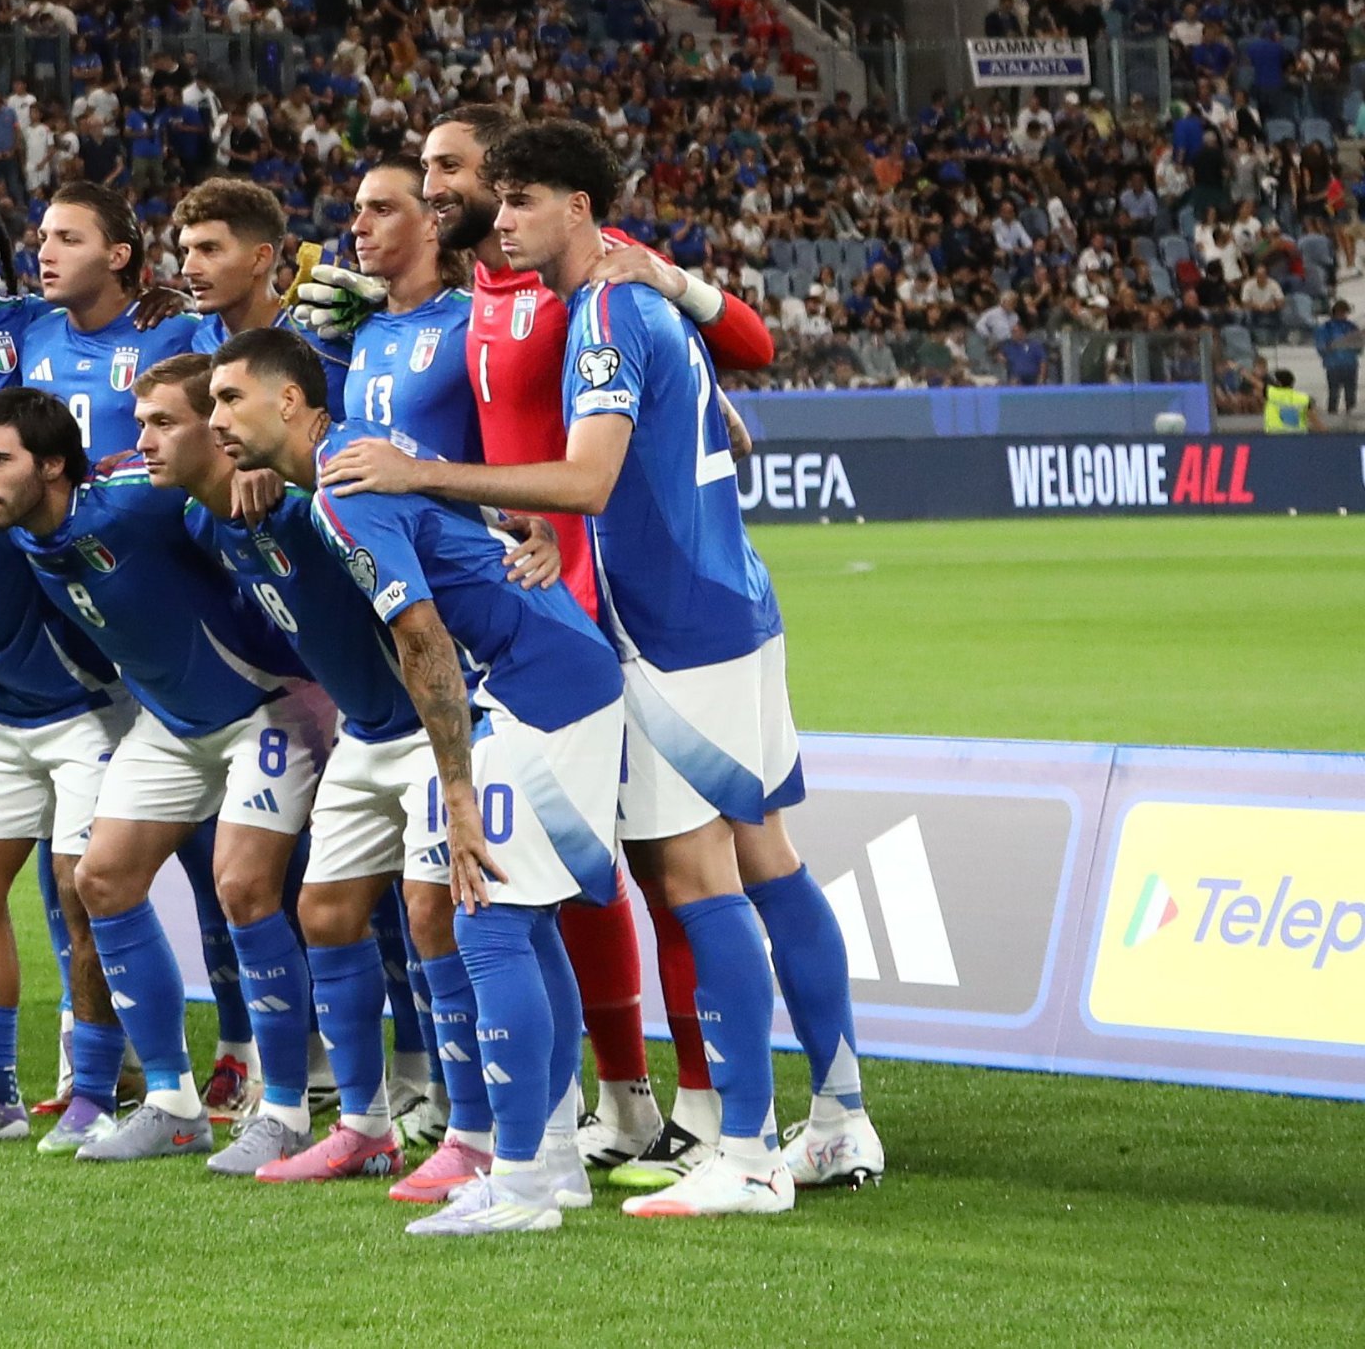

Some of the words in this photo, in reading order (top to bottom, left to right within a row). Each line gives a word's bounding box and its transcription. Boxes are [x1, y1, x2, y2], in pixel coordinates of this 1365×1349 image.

[990, 62, 1070, 75] ATALANTA
[479, 343, 491, 403] 1
[70, 394, 91, 448] 9
[365, 375, 394, 427] 13
[737, 453, 857, 510] UEFA
[1007, 443, 1169, 508] WELCOME
[1172, 443, 1255, 504] ALL
[67, 582, 106, 629] 8
[252, 582, 299, 633] 18
[258, 729, 287, 777] 8
[1193, 875, 1365, 970] Telep
